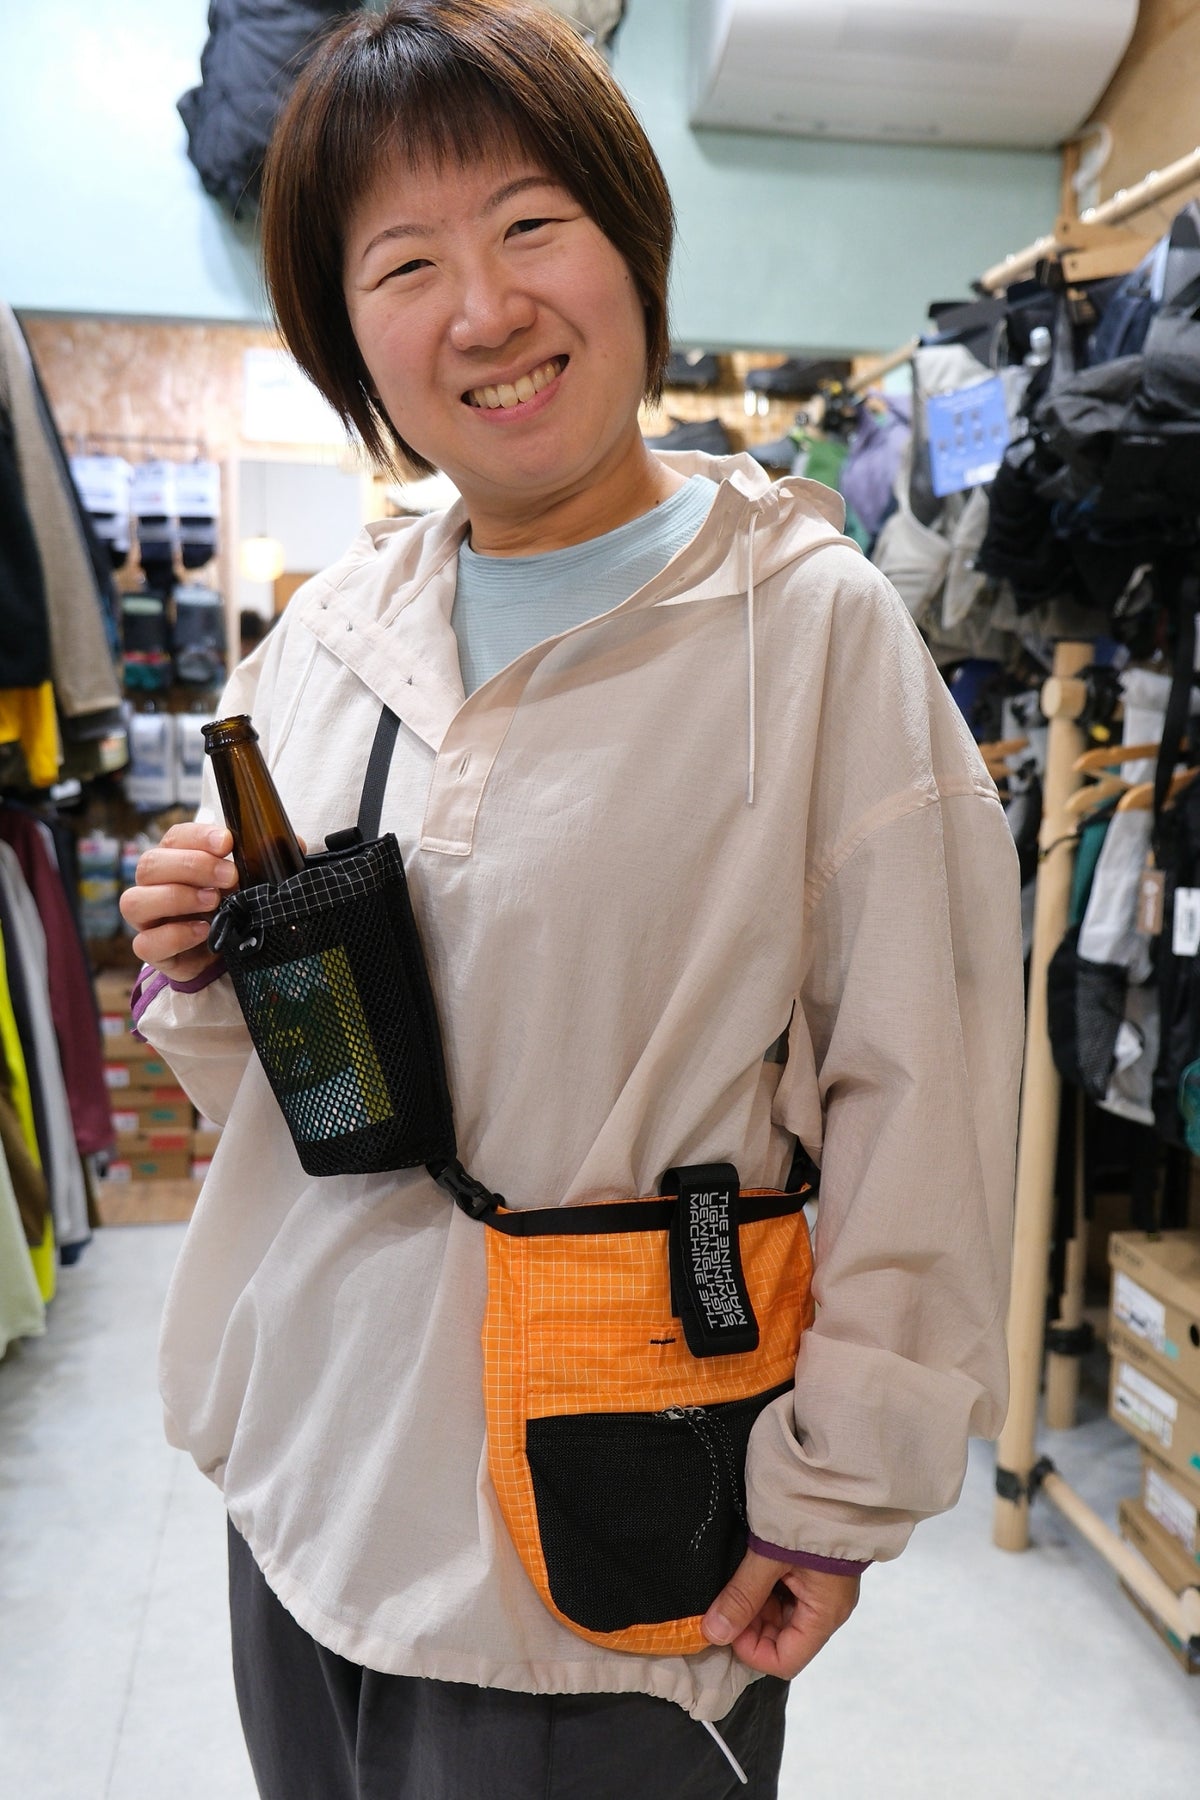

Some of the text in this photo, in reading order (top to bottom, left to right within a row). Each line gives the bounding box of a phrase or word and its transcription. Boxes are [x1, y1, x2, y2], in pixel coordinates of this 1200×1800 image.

[690, 1193, 706, 1285] MACHINE
[700, 1193, 712, 1269] SEWING
[709, 1192, 720, 1250] LIGHT
[719, 1192, 729, 1231] THE
[698, 1289, 718, 1329] THE
[704, 1271, 728, 1327] LIGHT
[710, 1250, 738, 1326] SEWING
[720, 1236, 748, 1325] MACHINE
